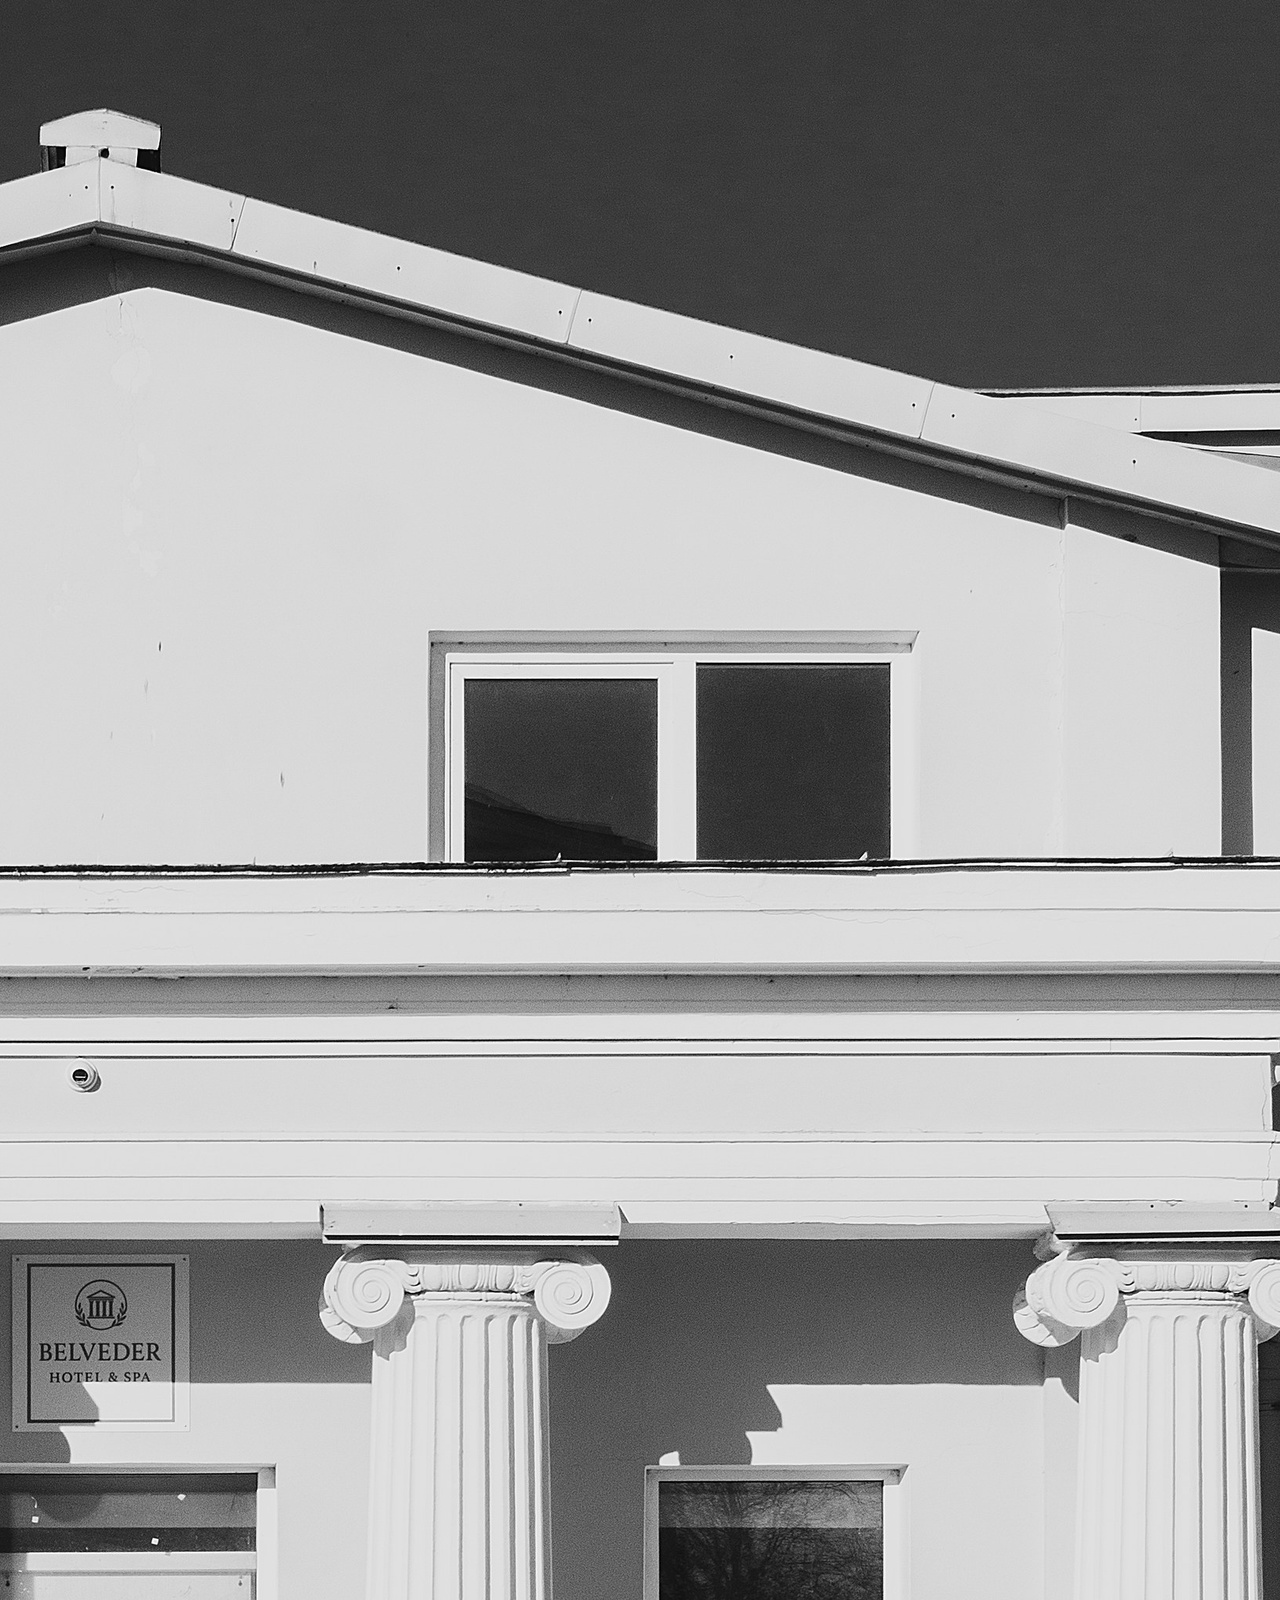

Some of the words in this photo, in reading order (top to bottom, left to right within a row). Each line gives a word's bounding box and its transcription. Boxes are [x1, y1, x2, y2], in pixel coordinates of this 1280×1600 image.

[39, 1343, 161, 1361] BELVEDER
[50, 1372, 103, 1383] HOTEL
[108, 1372, 118, 1382] &
[124, 1372, 151, 1382] SPA
